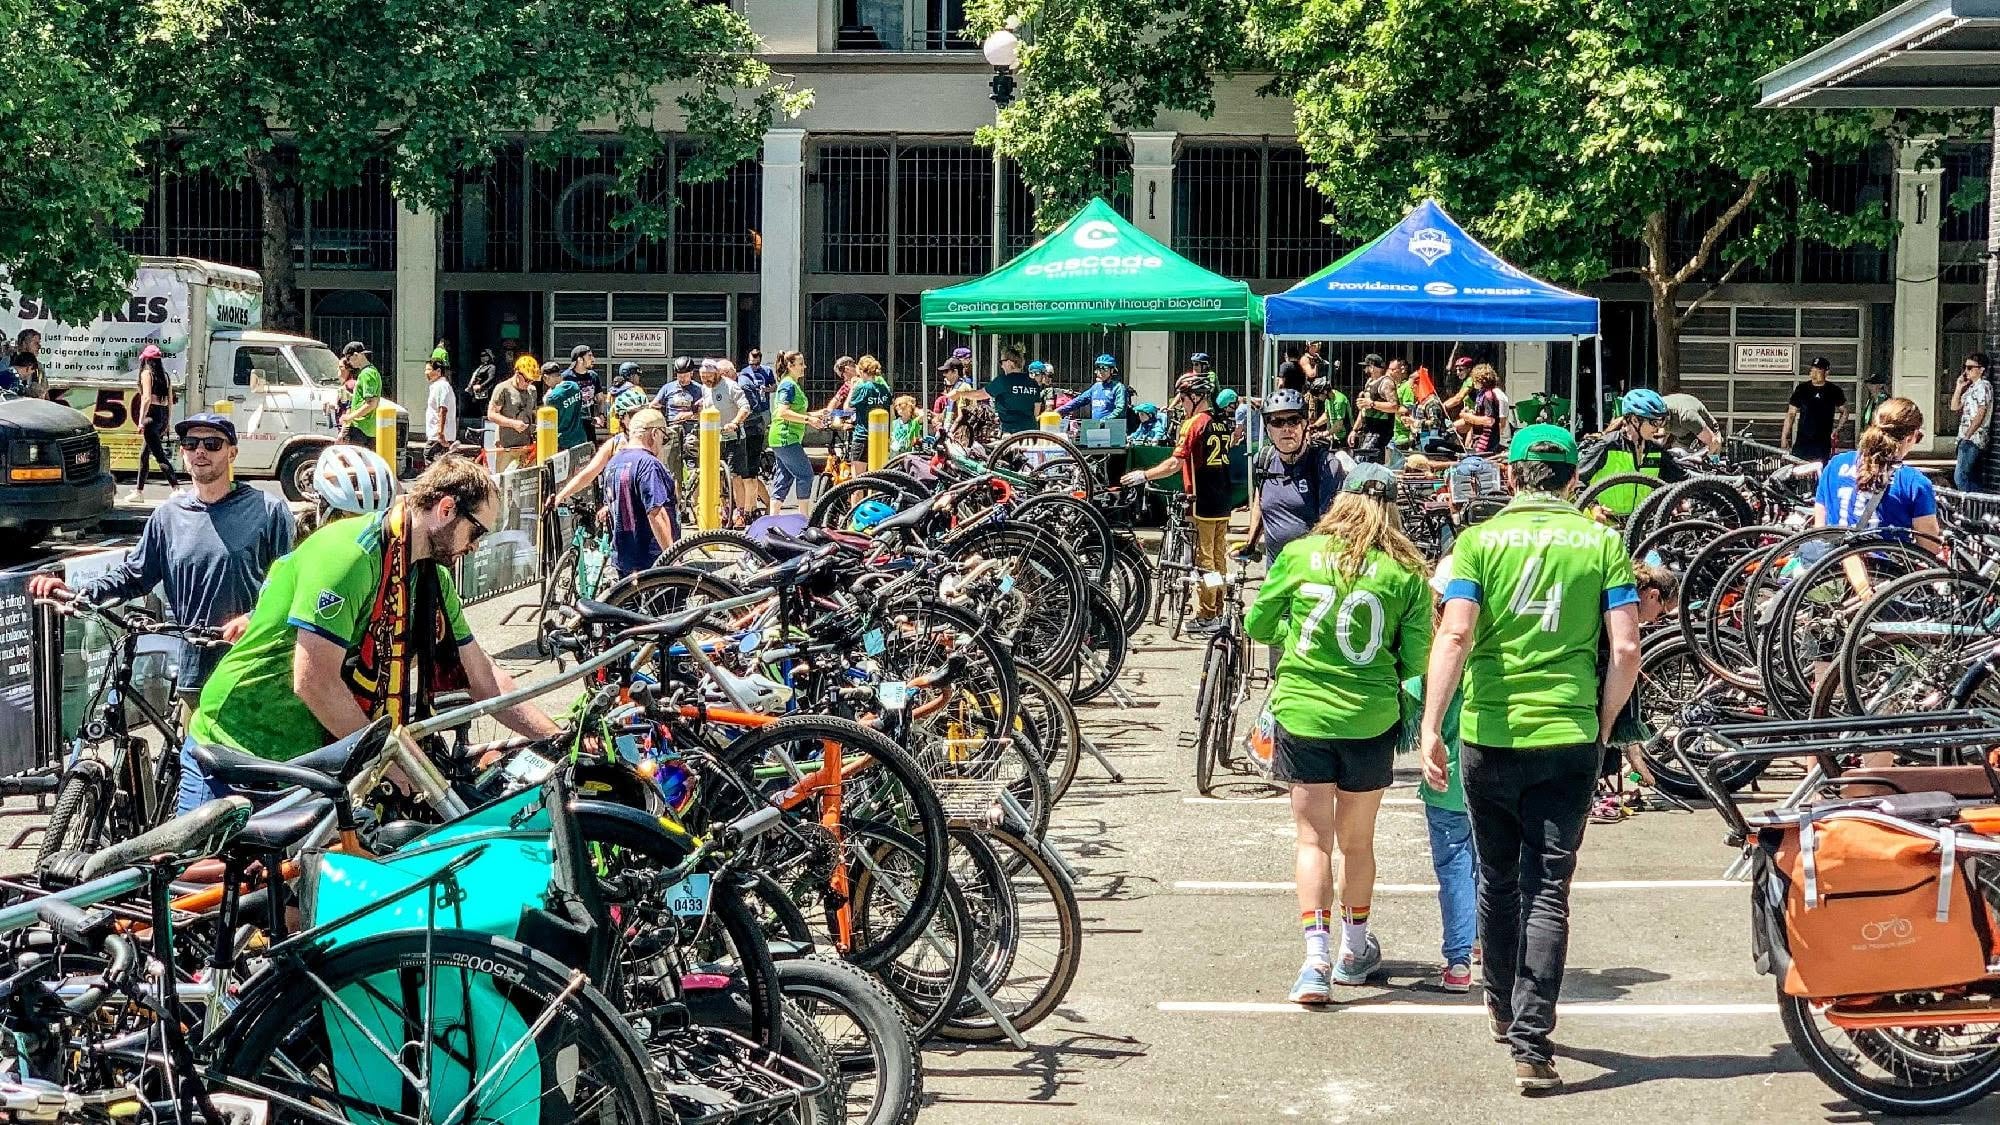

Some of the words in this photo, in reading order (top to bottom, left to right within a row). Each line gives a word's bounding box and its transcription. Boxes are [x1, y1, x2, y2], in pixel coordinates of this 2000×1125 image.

[1025, 255, 1163, 275] cascade
[1328, 281, 1419, 292] Providence
[1463, 287, 1531, 296] SWEDISH
[947, 301, 999, 313] Creating
[1001, 303, 1009, 311] a
[1013, 301, 1048, 311] better
[1050, 299, 1116, 311] community
[1119, 298, 1165, 310] through
[1168, 297, 1222, 309] bicycling
[217, 305, 248, 325] SMOKES
[64, 334, 90, 342] made
[162, 336, 172, 345] of
[618, 333, 628, 341] NO
[630, 333, 661, 341] PARKING
[54, 348, 99, 357] cigarettes
[1742, 348, 1753, 357] NO
[1755, 348, 1789, 357] PARKING
[64, 362, 83, 371] only
[1012, 385, 1037, 395] STAFF
[1509, 556, 1563, 632] 4
[1297, 582, 1385, 666] 70
[675, 899, 703, 911] 0433
